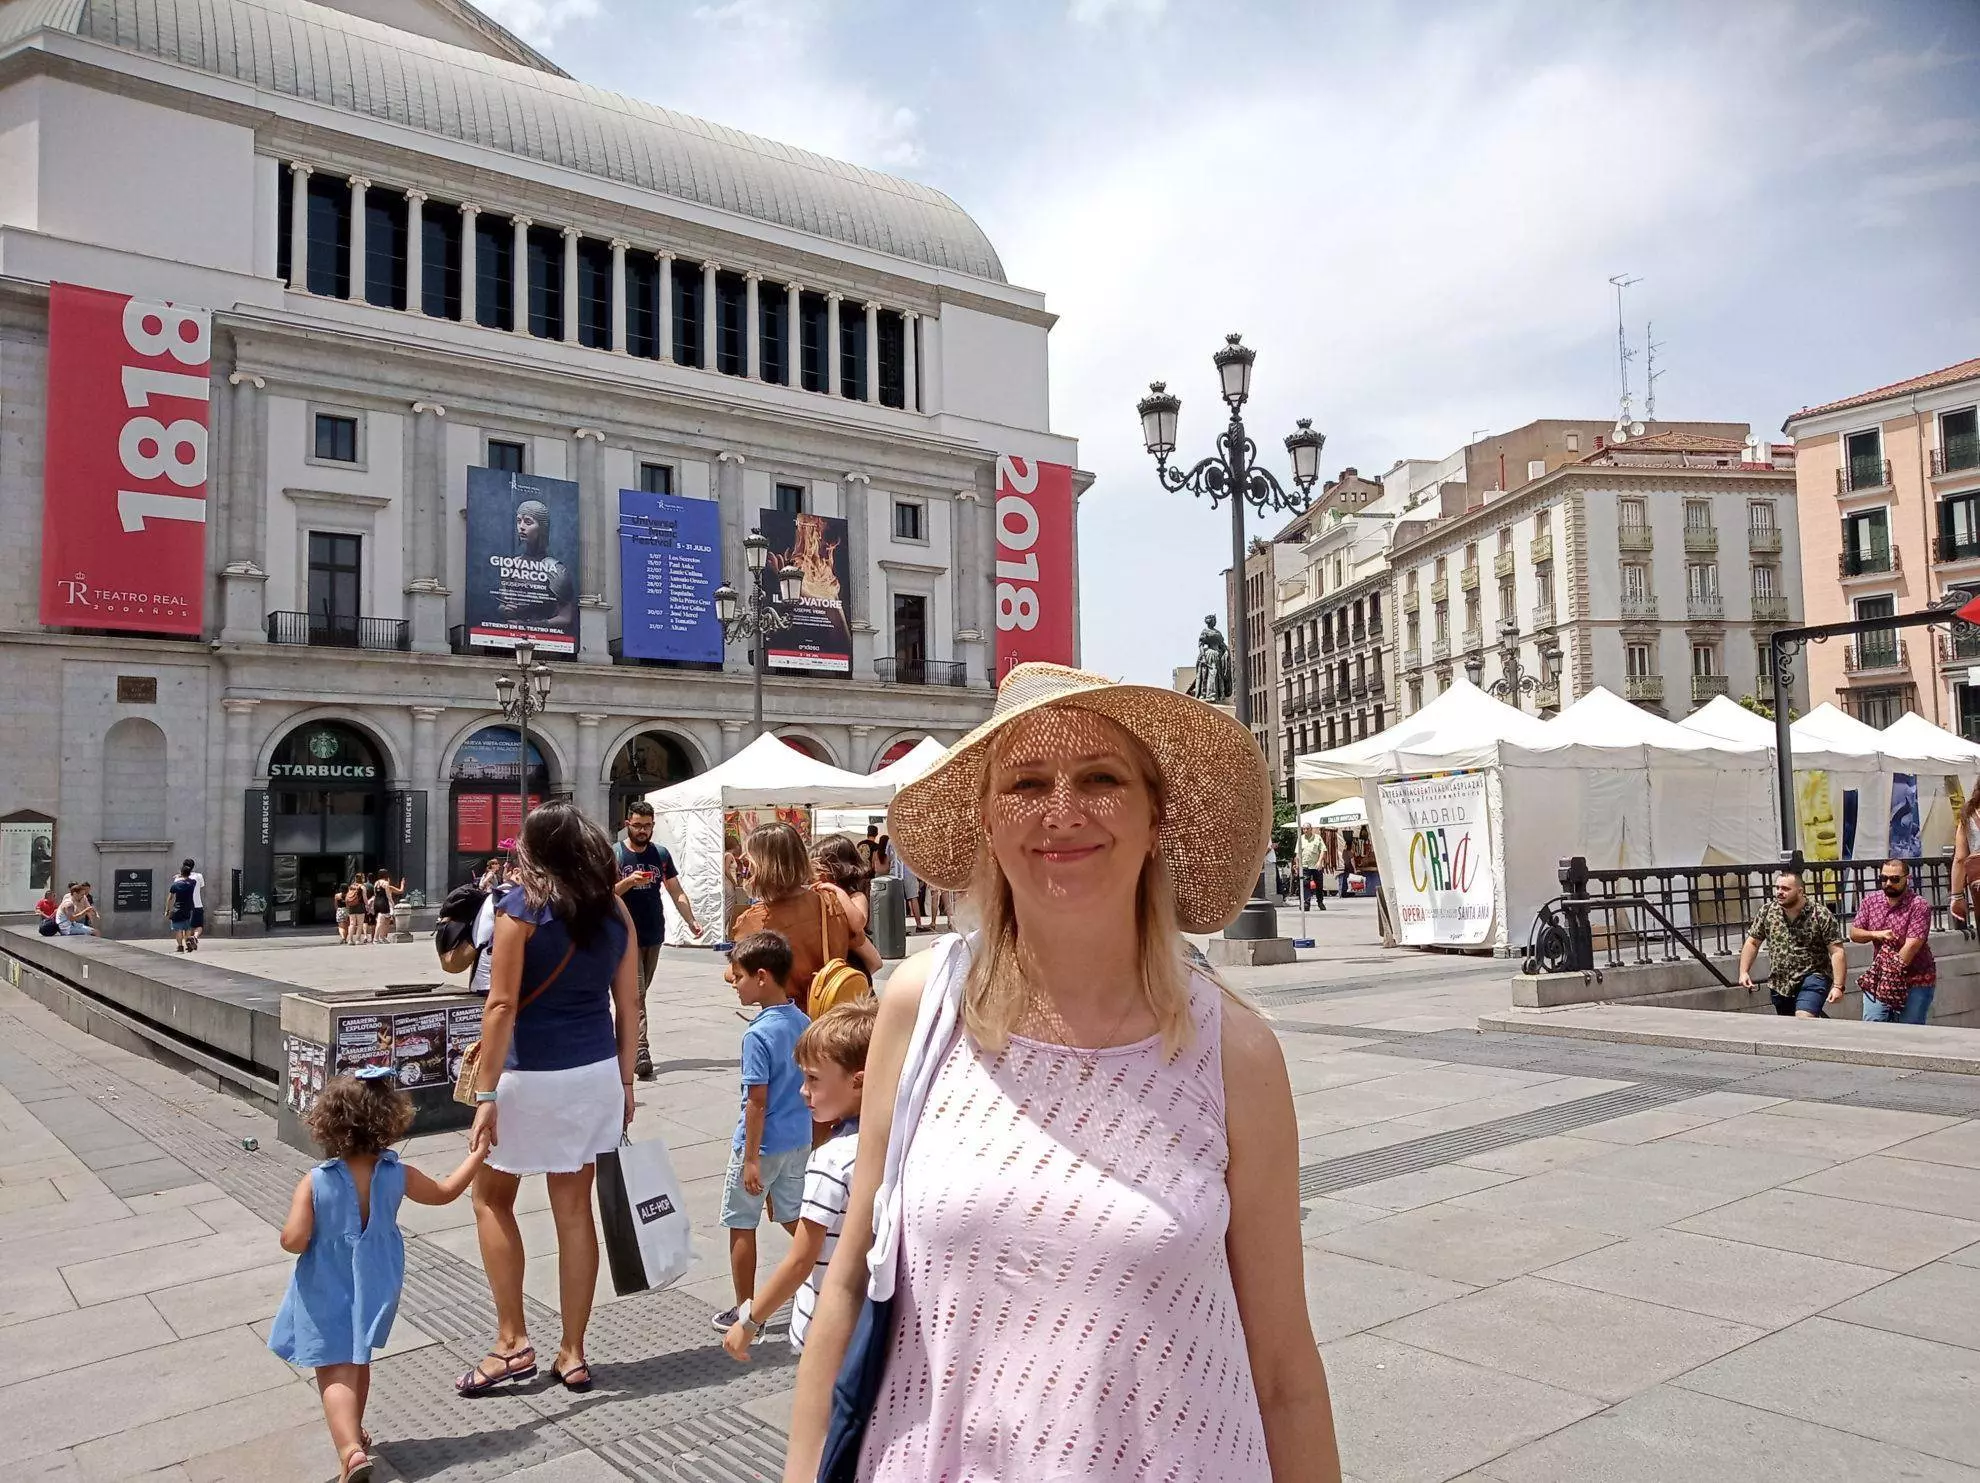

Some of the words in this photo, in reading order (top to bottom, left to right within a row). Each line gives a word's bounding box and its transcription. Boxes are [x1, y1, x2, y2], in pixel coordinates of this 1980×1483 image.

[117, 295, 212, 533] 1818
[996, 454, 1040, 631] 2018
[490, 556, 557, 573] GIOVANNA
[500, 568, 548, 582] D'ARCO
[95, 590, 147, 602] TEATRO
[154, 594, 188, 606] REAL
[271, 764, 375, 777] STARBUCKS
[1409, 806, 1466, 826] MADRID
[1402, 908, 1426, 922] OPERA
[1458, 906, 1476, 920] SANTA
[342, 1017, 377, 1026] CAMARERO
[346, 1022, 382, 1032] EXPLOTADO
[342, 1046, 376, 1055] CAMARERO
[348, 1050, 389, 1061] ORGANIZADO
[641, 1199, 670, 1219] ALE-HOP
